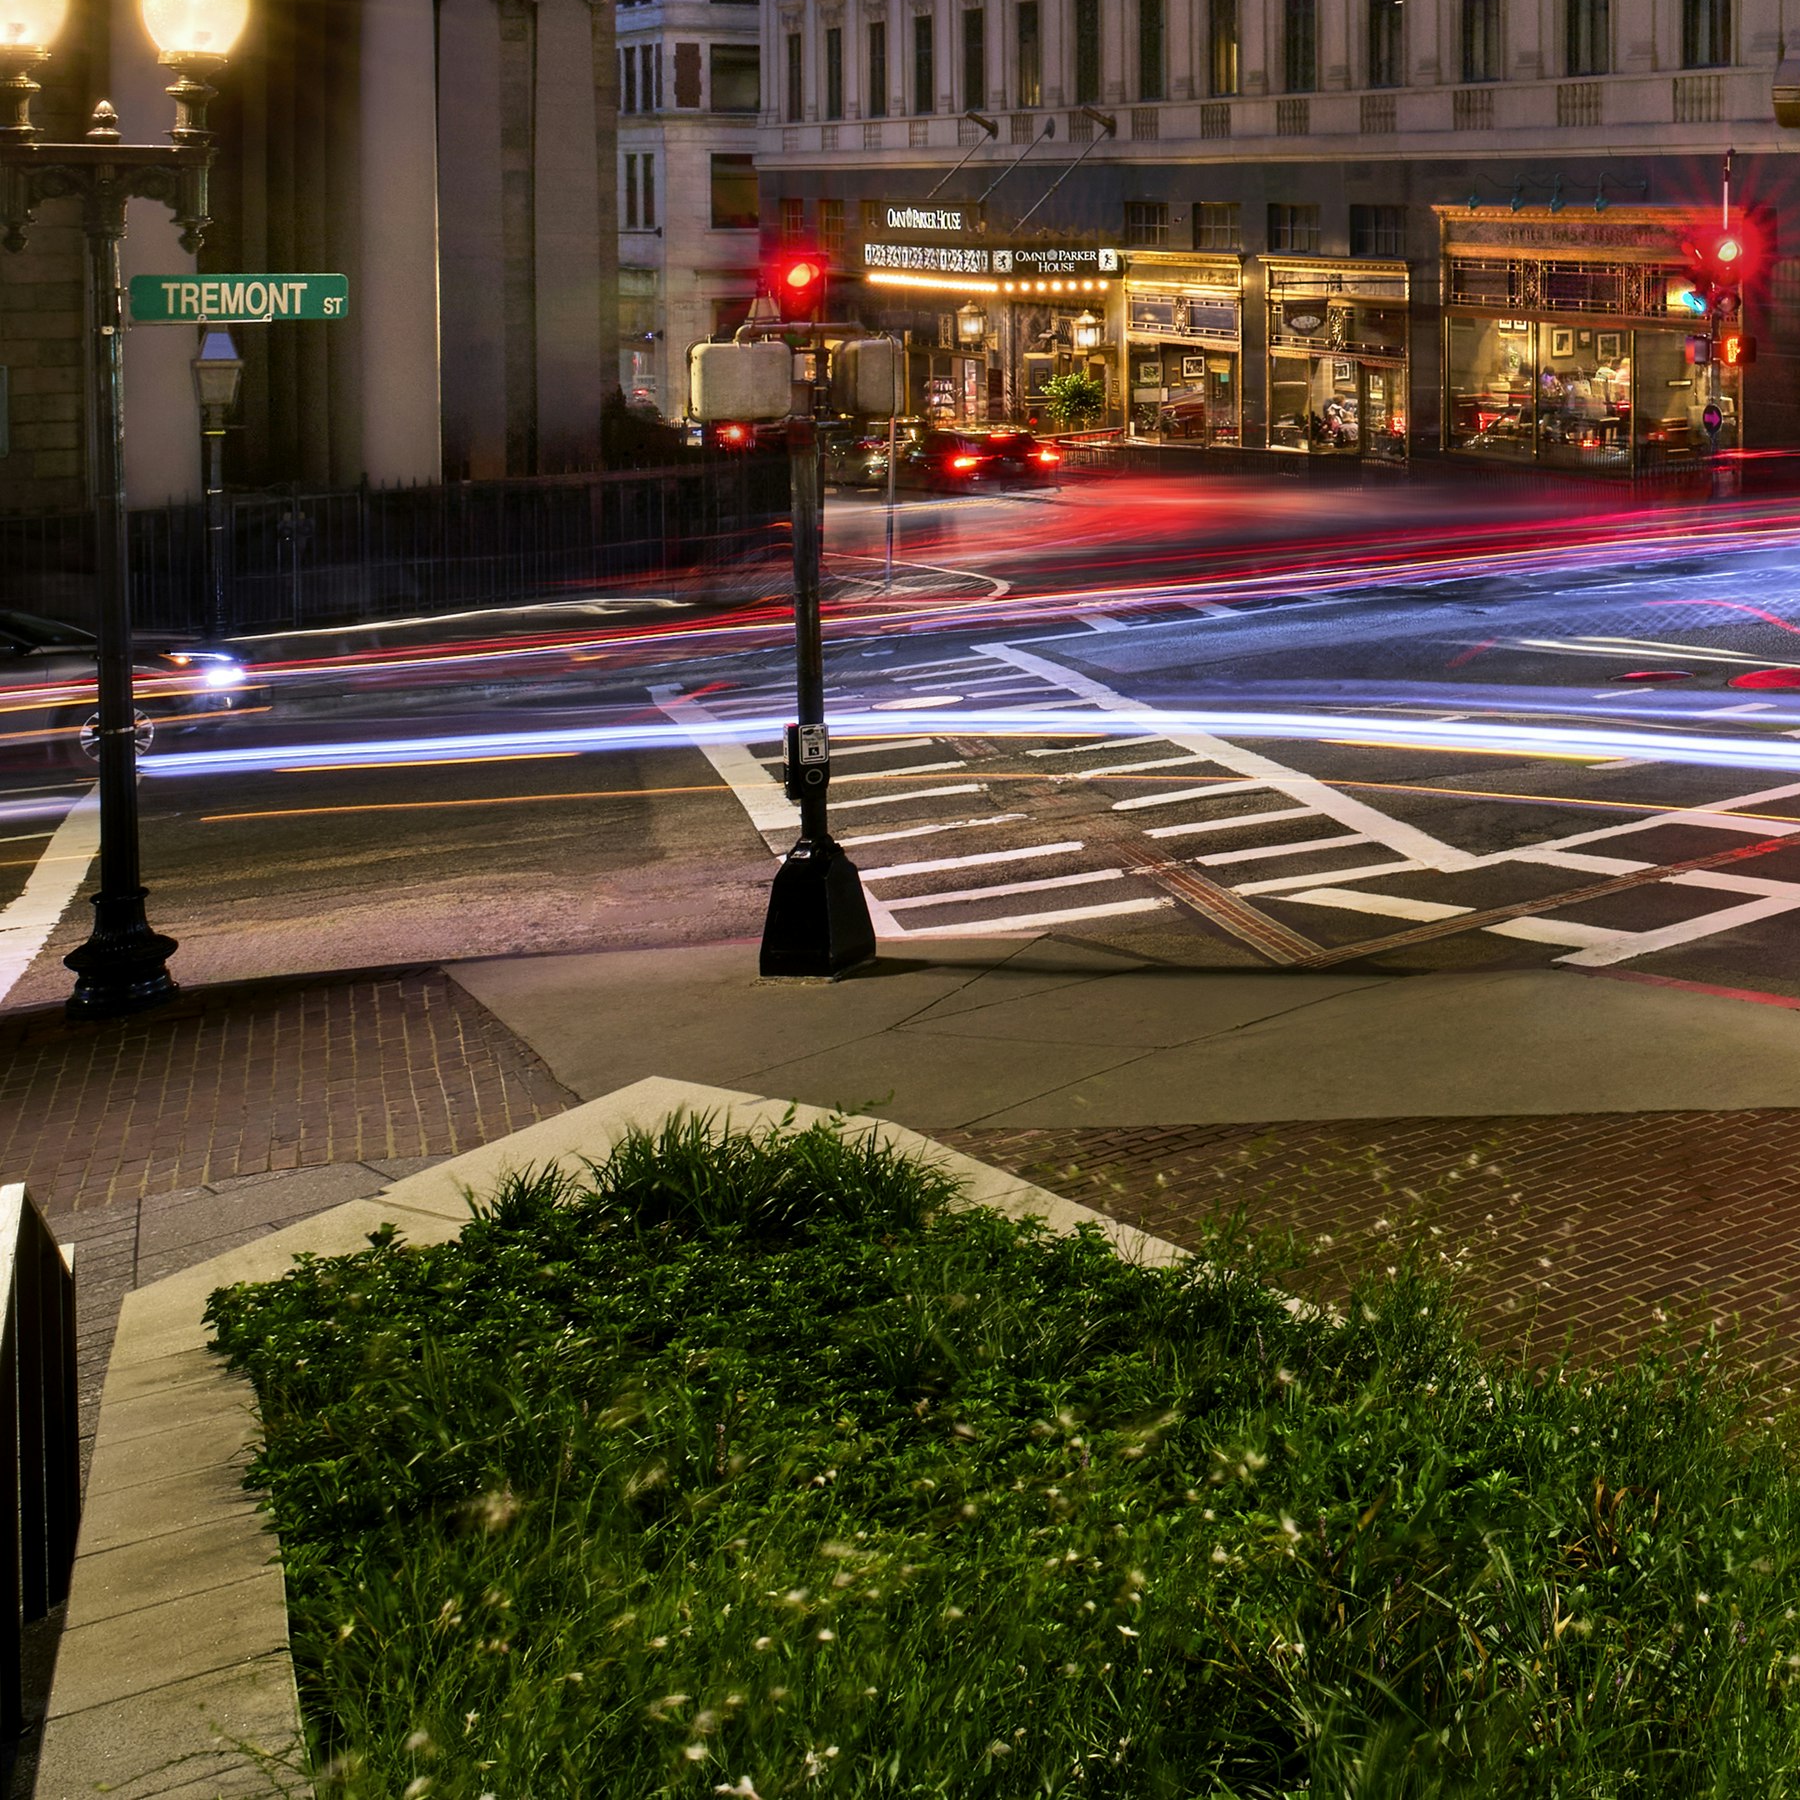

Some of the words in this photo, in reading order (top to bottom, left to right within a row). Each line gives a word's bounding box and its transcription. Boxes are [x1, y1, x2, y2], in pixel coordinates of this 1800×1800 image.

[887, 207, 906, 228] OMNI
[1015, 250, 1046, 262] OMNI
[1058, 250, 1097, 261] PARKER
[1038, 262, 1075, 272] HOUSE
[161, 281, 308, 315] TREMONT
[323, 296, 344, 314] ST
